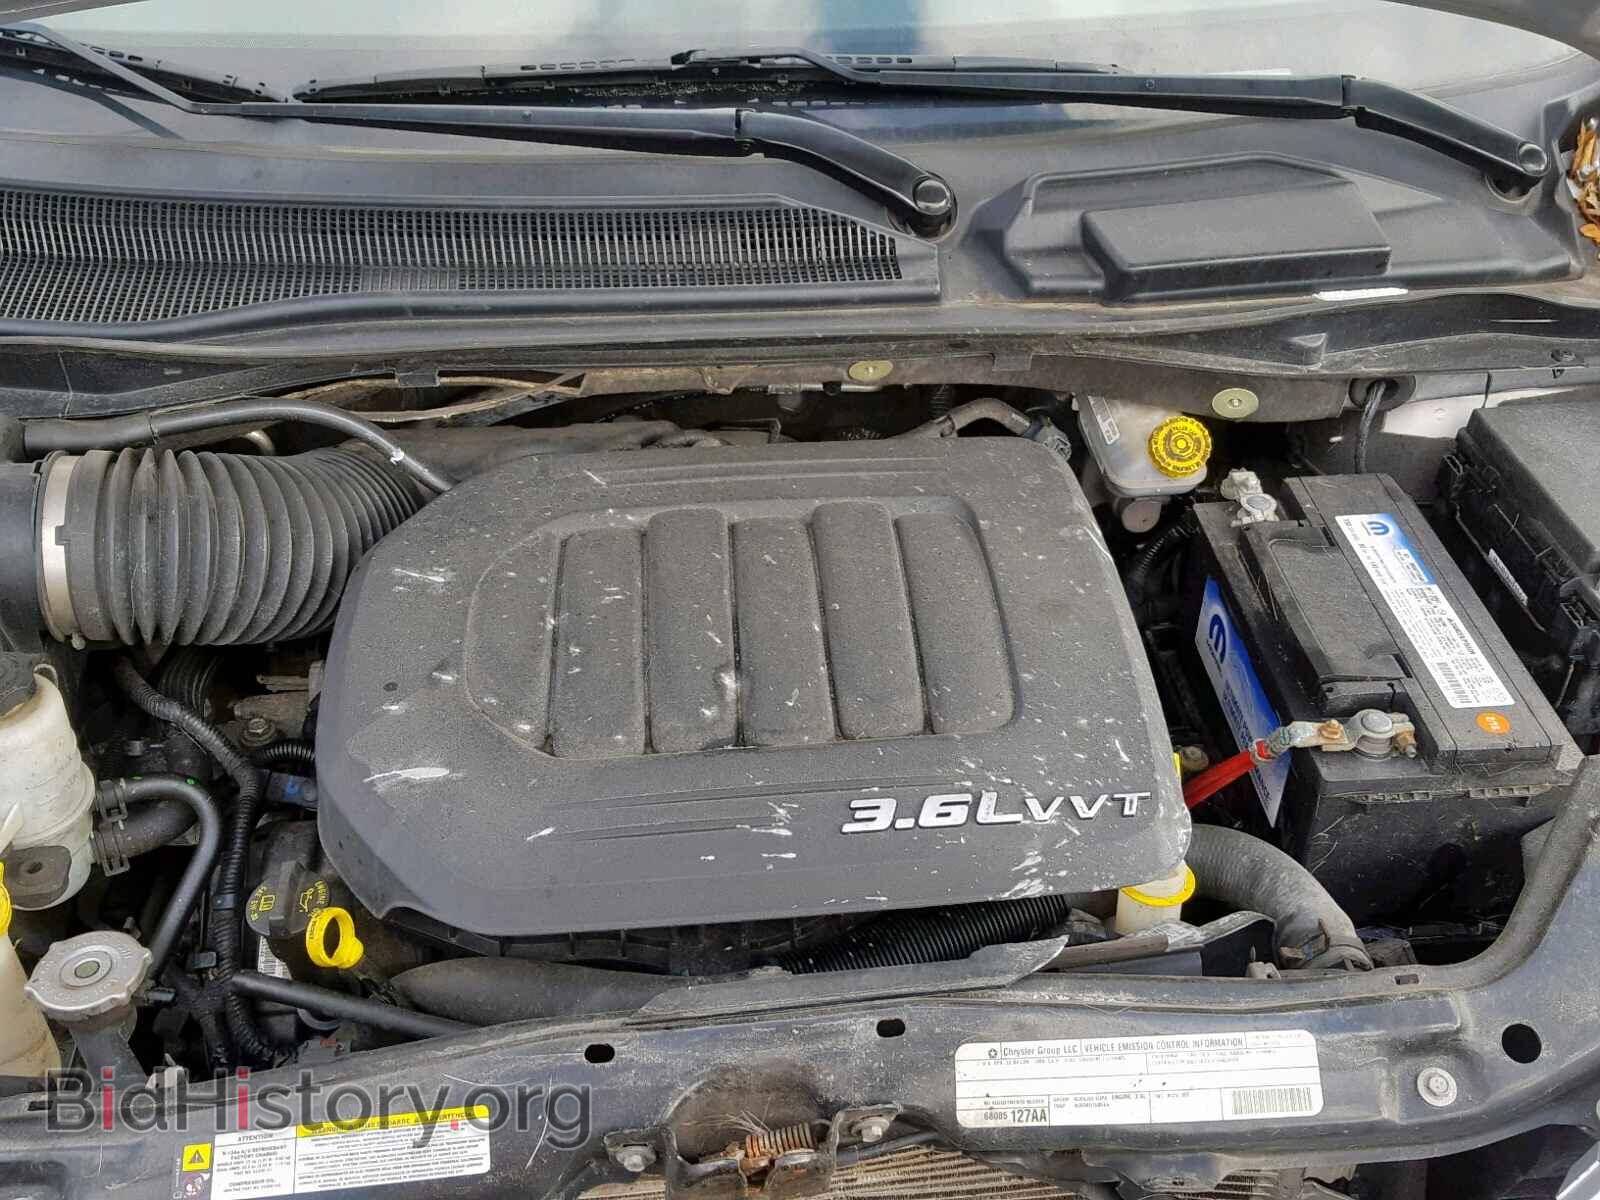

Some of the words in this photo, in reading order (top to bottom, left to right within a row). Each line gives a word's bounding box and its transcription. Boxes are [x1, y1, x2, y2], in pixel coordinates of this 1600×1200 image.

[1003, 1046, 1035, 1059] Chrysler
[1037, 1045, 1061, 1057] Group
[1063, 1044, 1079, 1055] LLC
[1084, 1041, 1115, 1053] VEHICLE
[1117, 1039, 1154, 1052] EMISSION
[1156, 1039, 1190, 1050] CONTROL
[1192, 1037, 1244, 1049] INFORMATION
[983, 1110, 1009, 1122] 68085
[1010, 1108, 1048, 1124] 127AA
